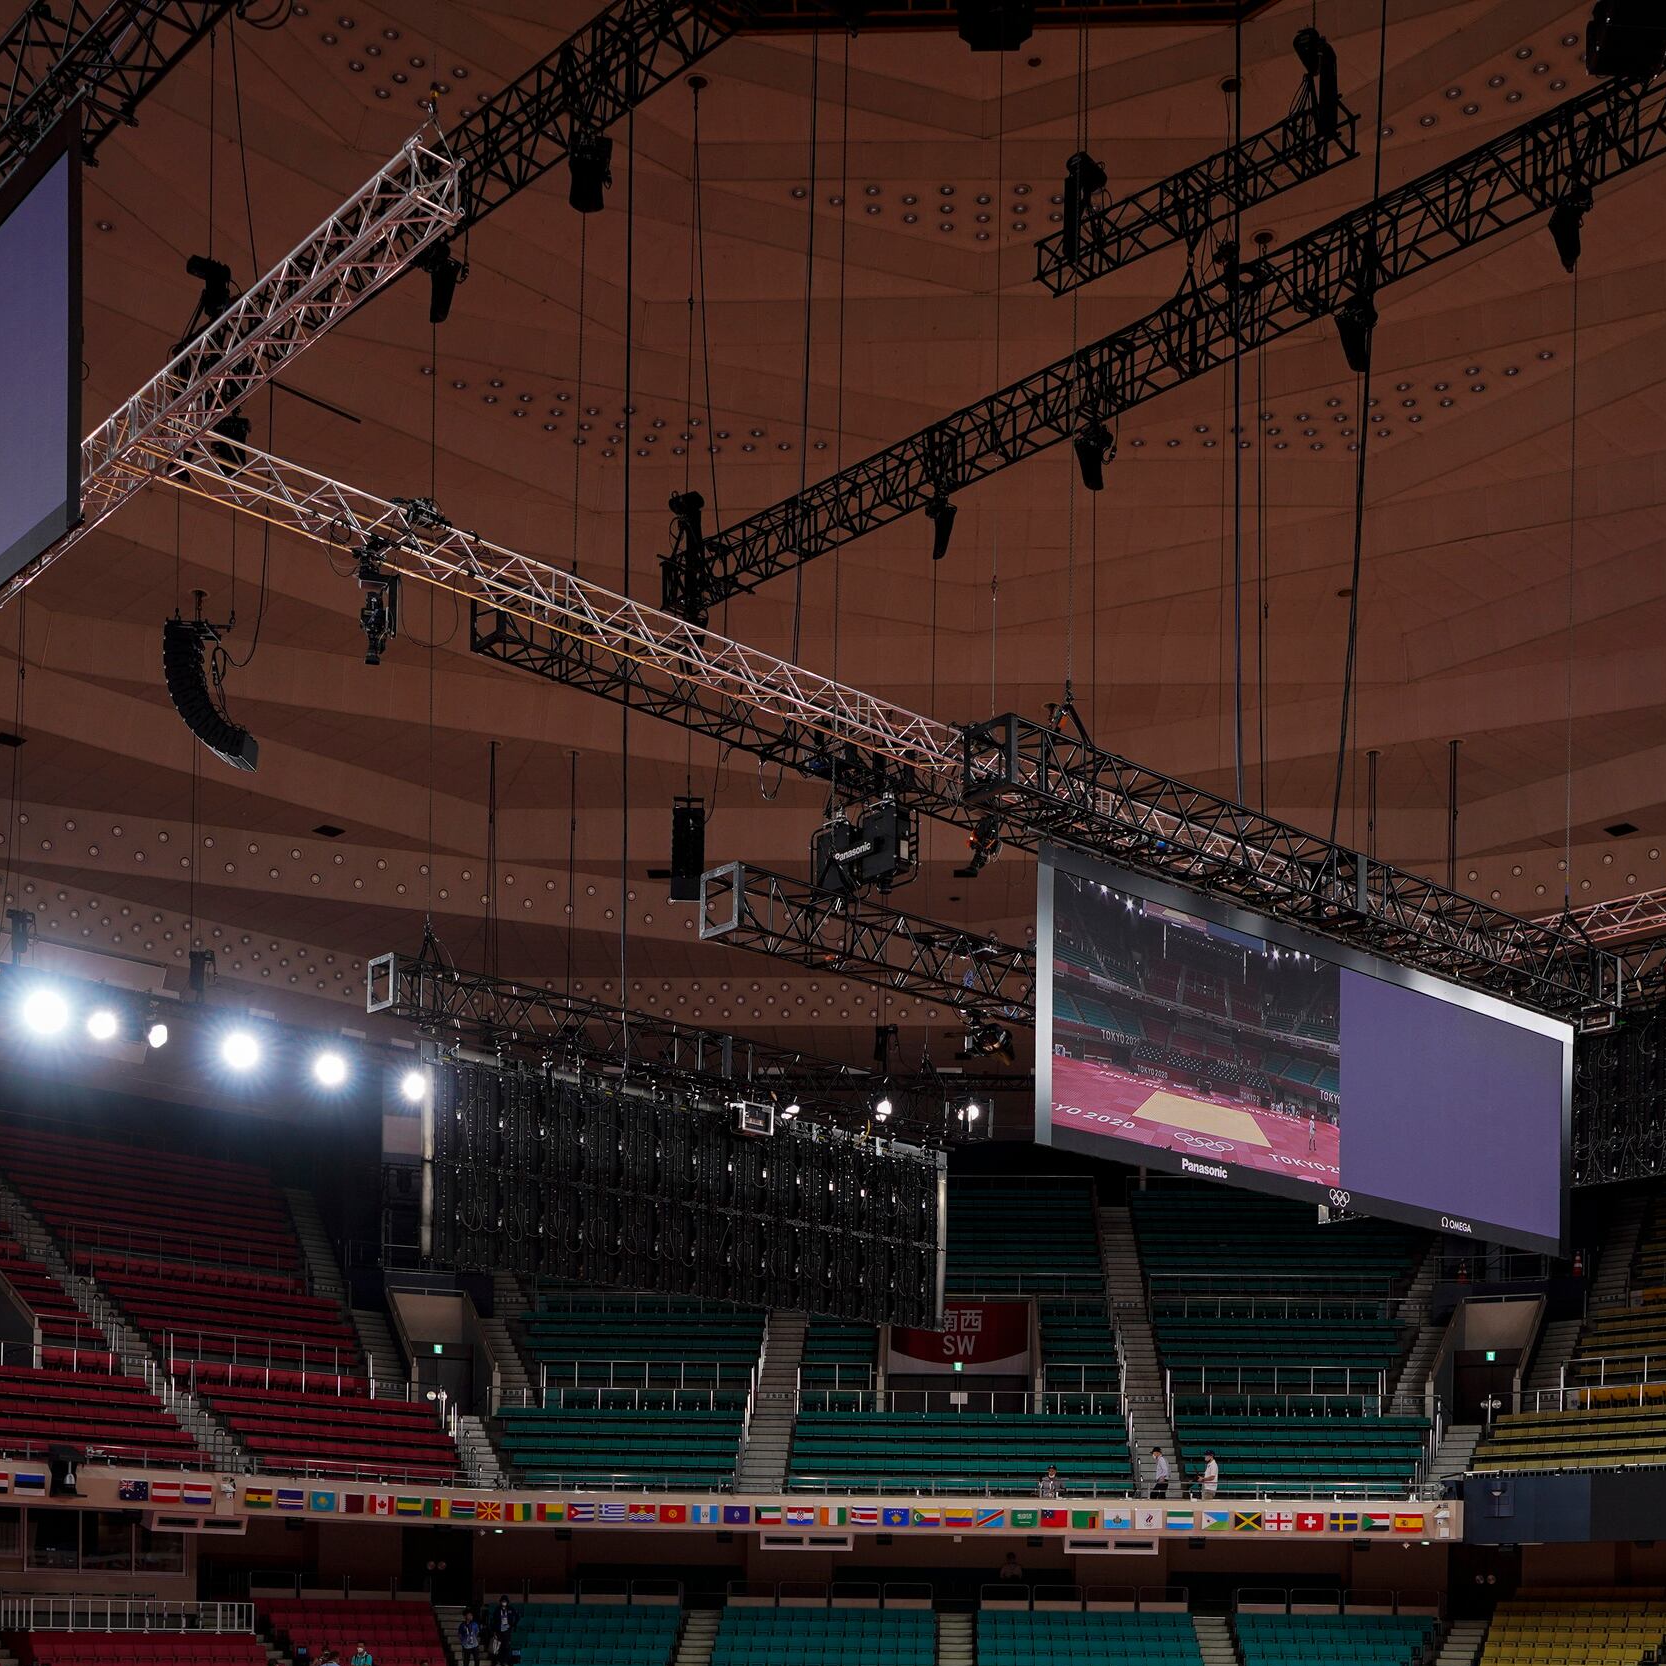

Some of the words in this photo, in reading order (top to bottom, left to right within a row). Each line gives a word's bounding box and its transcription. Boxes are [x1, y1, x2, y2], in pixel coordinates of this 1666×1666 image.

[1101, 1030, 1123, 1044] TOKYO
[1137, 1065, 1153, 1078] TOKYO
[1154, 1068, 1168, 1080] 2020
[1084, 1110, 1136, 1129] 2020
[1181, 1158, 1228, 1179] Panasonic
[1269, 1153, 1324, 1170] TOKYO
[1449, 1220, 1472, 1233] OMEGA
[943, 1335, 976, 1355] SW
